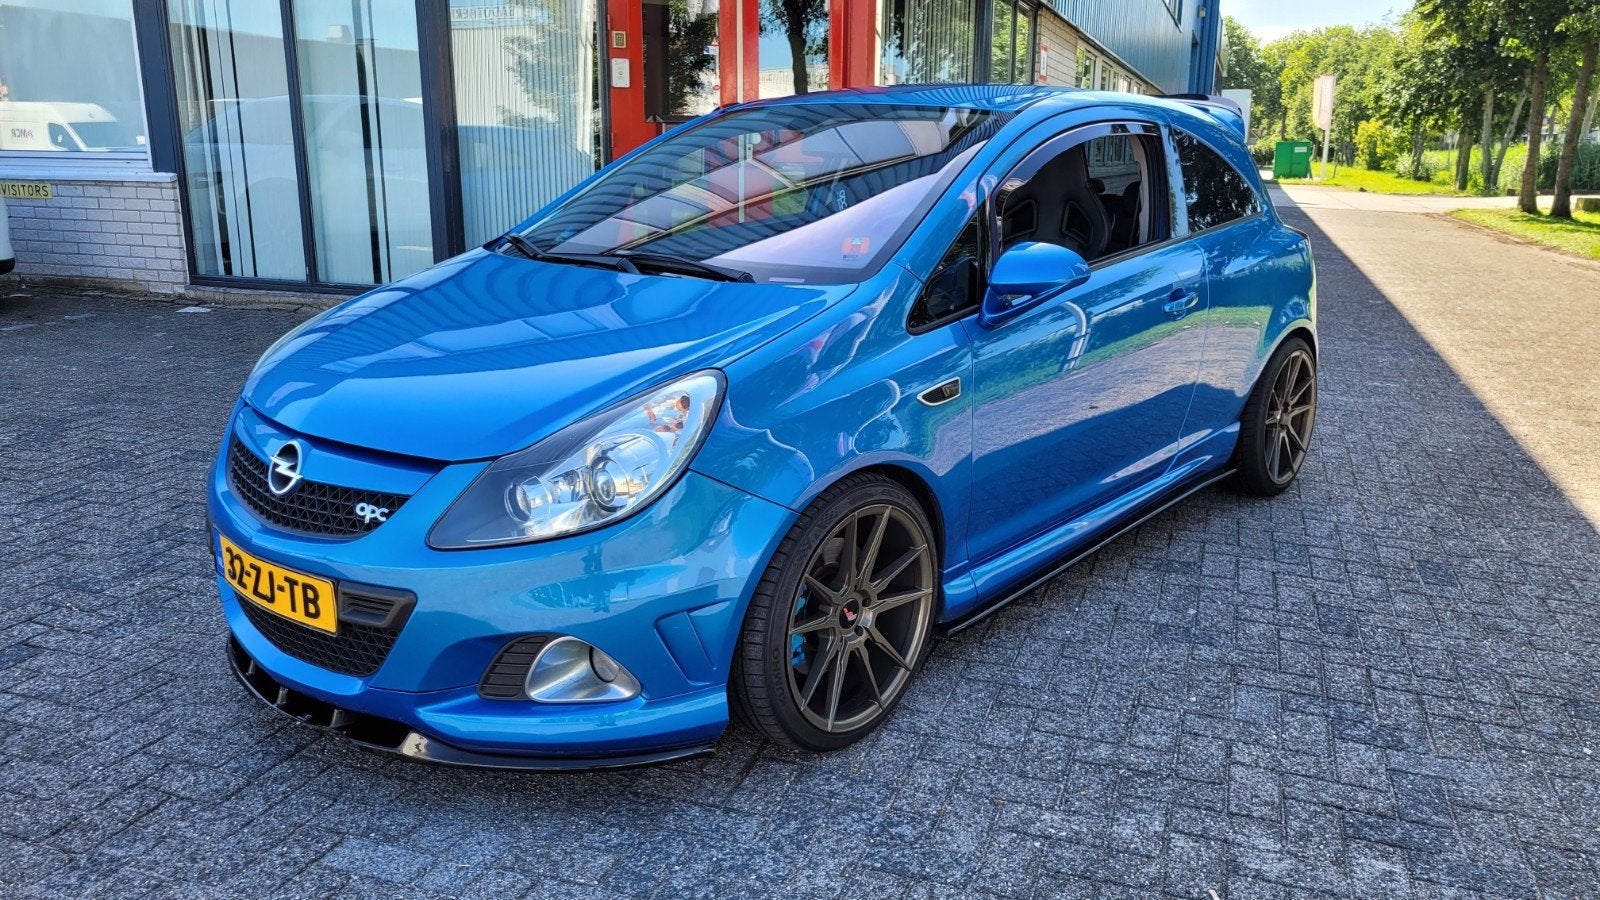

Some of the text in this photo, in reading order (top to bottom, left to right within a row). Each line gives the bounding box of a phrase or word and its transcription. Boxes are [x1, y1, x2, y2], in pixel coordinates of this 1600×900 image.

[0, 184, 49, 197] VISITORS
[355, 502, 389, 523] opc
[225, 546, 321, 619] 32-ZJ-TB
